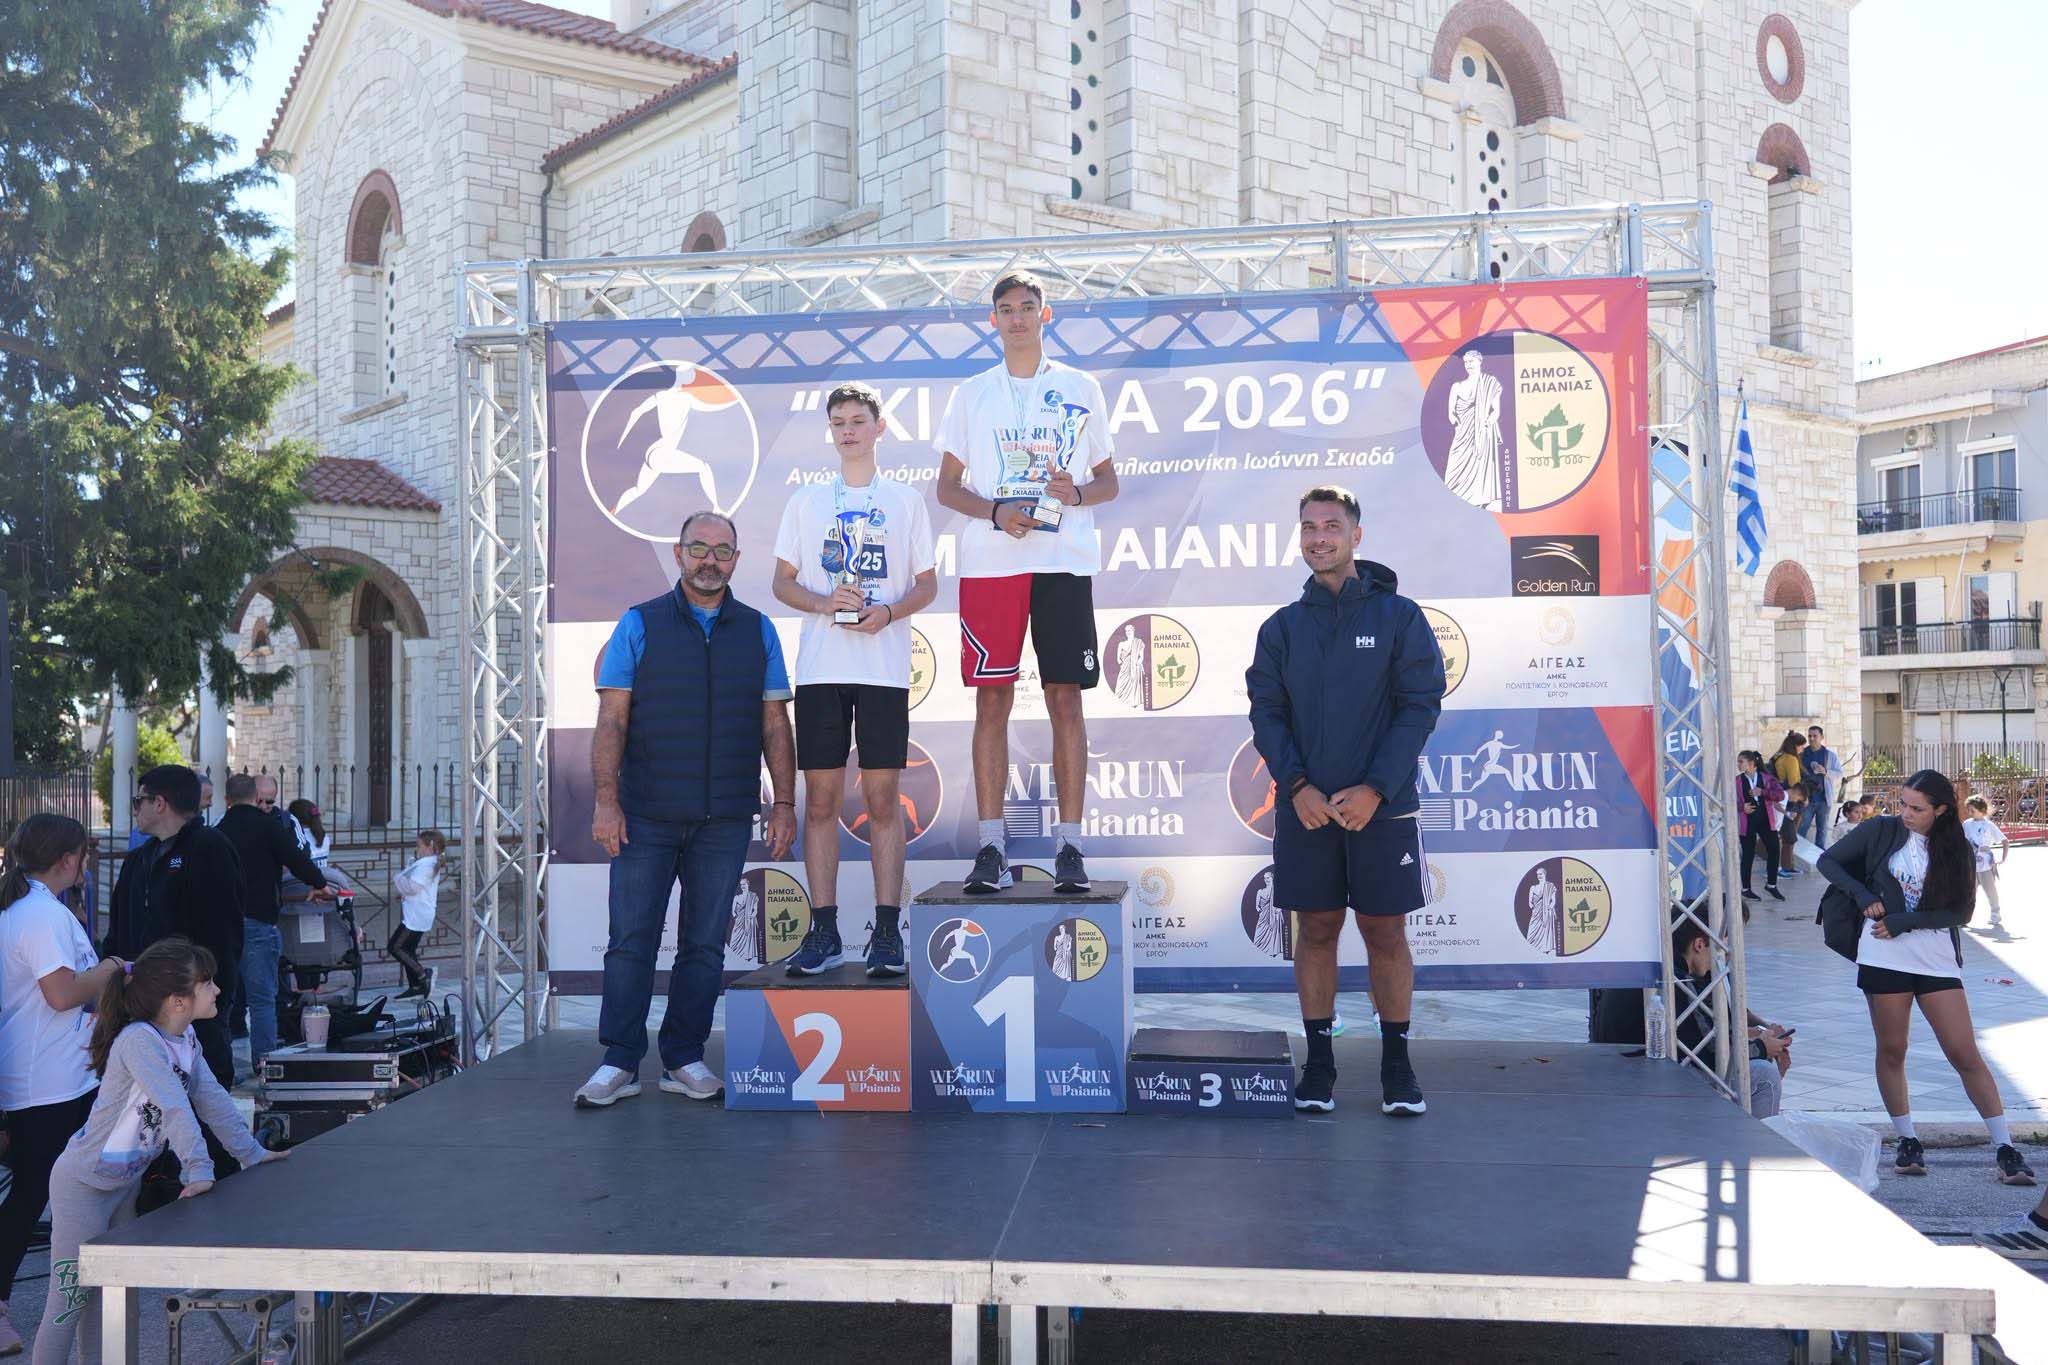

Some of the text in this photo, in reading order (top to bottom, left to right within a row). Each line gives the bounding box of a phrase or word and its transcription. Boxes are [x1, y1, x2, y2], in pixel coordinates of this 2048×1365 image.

[1520, 366, 1576, 379] ΔΗΜΟΣ
[1520, 379, 1593, 393] ΠΑΙΑΝΙΑΣ
[1113, 452, 1238, 476] αλκανιονίκη
[1244, 451, 1319, 470] Ιωάννη
[1325, 446, 1396, 467] Σκιαδά
[1516, 578, 1596, 593] Golden Run
[1153, 634, 1183, 642] ΔΗΜΟΣ
[1355, 636, 1375, 646] HH
[1436, 633, 1460, 641] ΑΝΙΑΣ
[1153, 641, 1191, 649] ΠΑΙΑΝΙΑΣ
[1527, 656, 1586, 669] ΑΙΓΕΑΣ
[1511, 752, 1599, 791] RUN
[1098, 760, 1185, 799] RUN
[1453, 798, 1600, 832] Paiania
[1565, 877, 1593, 885] ΔΗΜΟΣ
[1565, 885, 1602, 893] ΠΑΙΑΝΙΑΣ
[1409, 914, 1457, 926] ΙΓΕΑΣ
[1145, 950, 1169, 958] ΕΡΓΟΥ
[971, 975, 1036, 1102] 1
[791, 1012, 845, 1102] 2
[731, 1071, 786, 1083] WE RUN
[845, 1070, 902, 1083] WE RUN
[930, 1069, 996, 1084] WE RUN
[1044, 1069, 1112, 1084] WE RUN
[1134, 1076, 1192, 1090] WE RUN
[744, 1083, 786, 1094] Paiania
[859, 1082, 901, 1093] Paiania
[946, 1084, 995, 1097] Paiania
[1062, 1084, 1112, 1097] Paiania
[1198, 1072, 1223, 1108] 3
[1230, 1077, 1288, 1091] WE RUN
[1149, 1089, 1192, 1101] Paiania
[1245, 1090, 1288, 1102] Paiania
